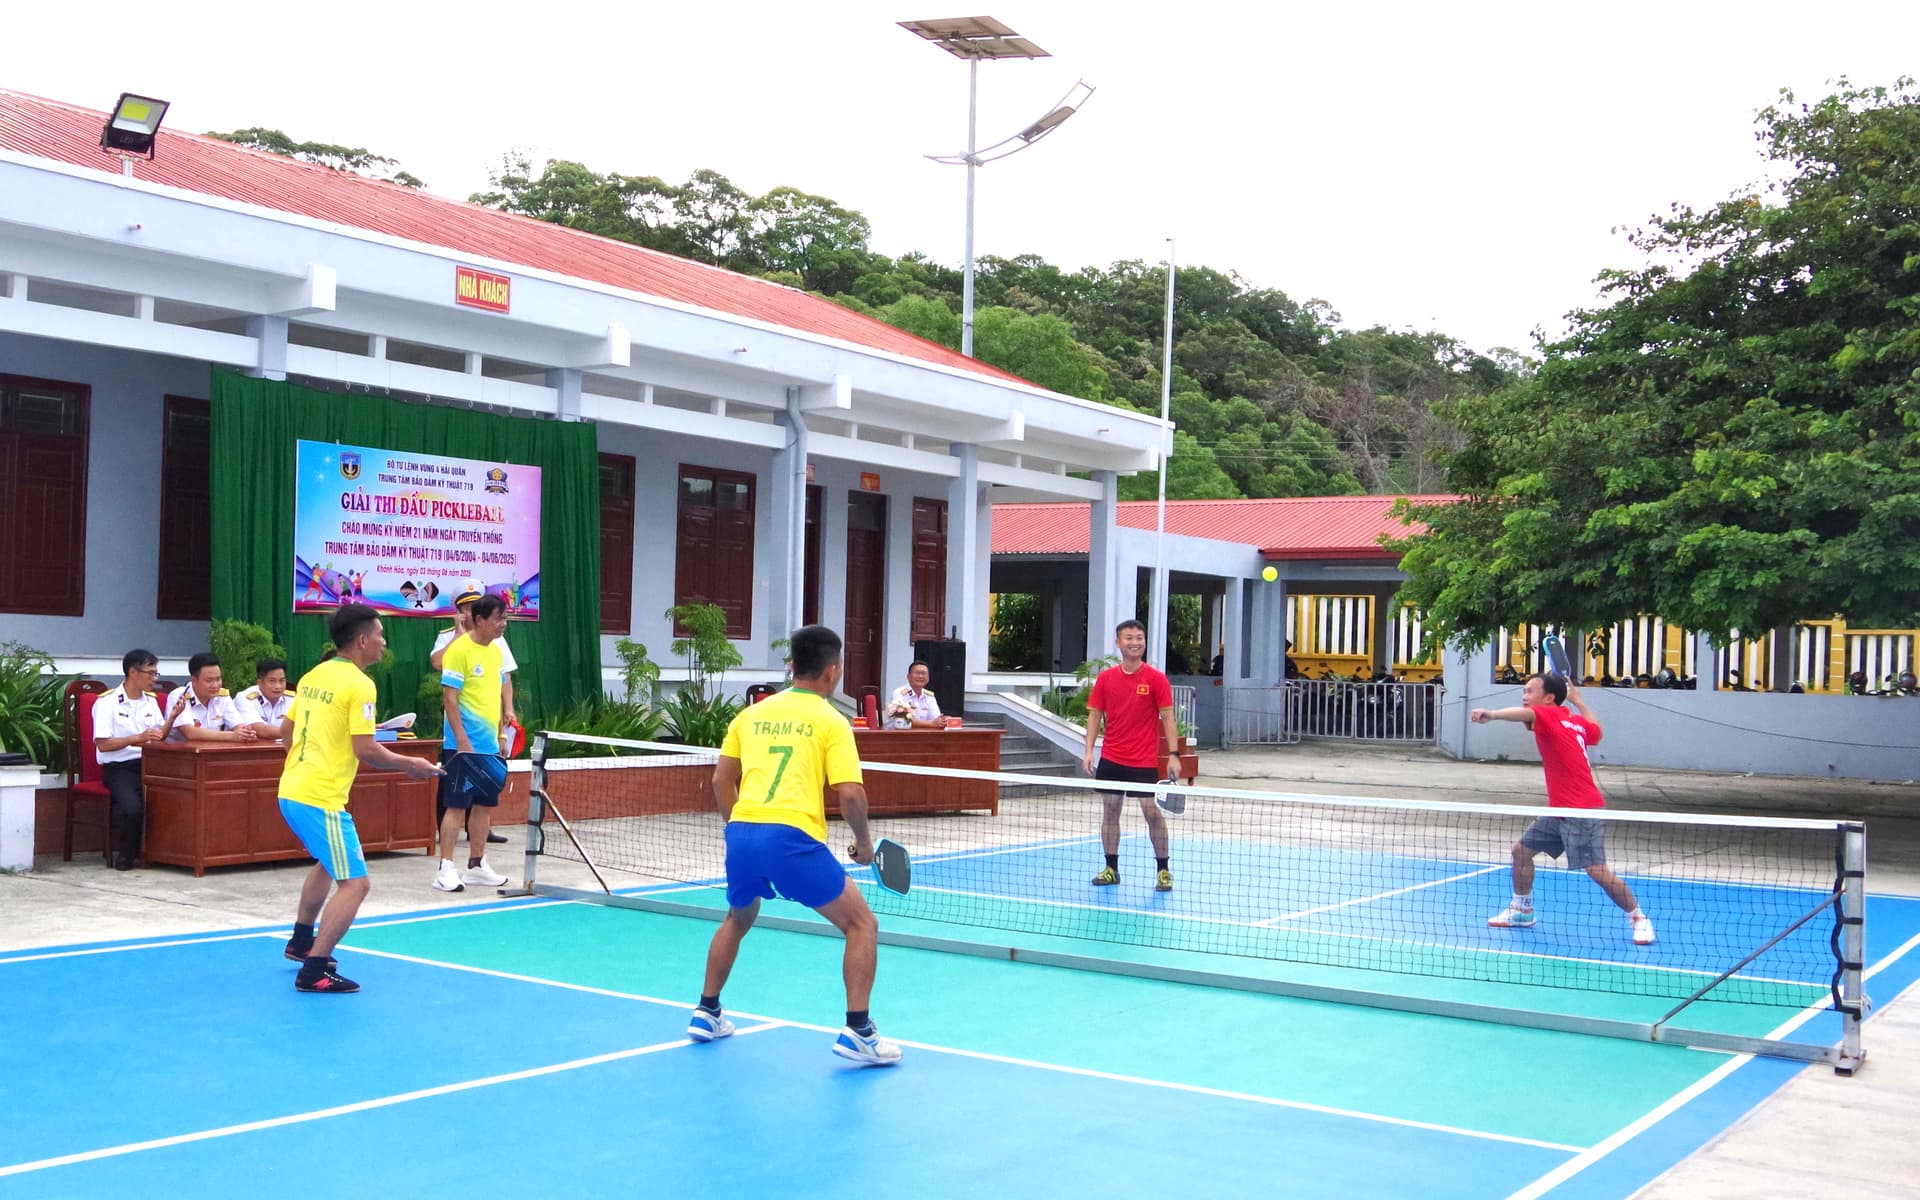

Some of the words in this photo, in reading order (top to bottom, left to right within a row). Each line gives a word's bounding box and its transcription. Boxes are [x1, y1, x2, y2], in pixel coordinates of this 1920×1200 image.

[459, 272, 477, 299] NHÀ
[480, 277, 508, 305] KHÁCH
[378, 474, 396, 484] TRUNG
[464, 482, 473, 491] 719
[341, 486, 370, 512] GIẢI
[374, 495, 396, 514] THI
[400, 490, 428, 516] ĐẤU
[431, 500, 505, 522] PICKLEBALL
[342, 520, 360, 534] CHÀO
[362, 521, 383, 536] MỪNG
[395, 523, 412, 540] NIỆM
[413, 527, 421, 539] 21
[423, 526, 438, 540] NĂM
[440, 526, 456, 541] NGÀY
[483, 529, 503, 544] THỐNG
[325, 541, 348, 555] TRUNG
[350, 541, 364, 556] TÂM
[366, 540, 380, 556] BẢO
[409, 545, 429, 562] THUẬT
[430, 548, 441, 561] 719
[460, 569, 471, 577] 2025
[320, 690, 334, 704] 43
[796, 722, 814, 737] 43
[762, 745, 794, 806] 7
